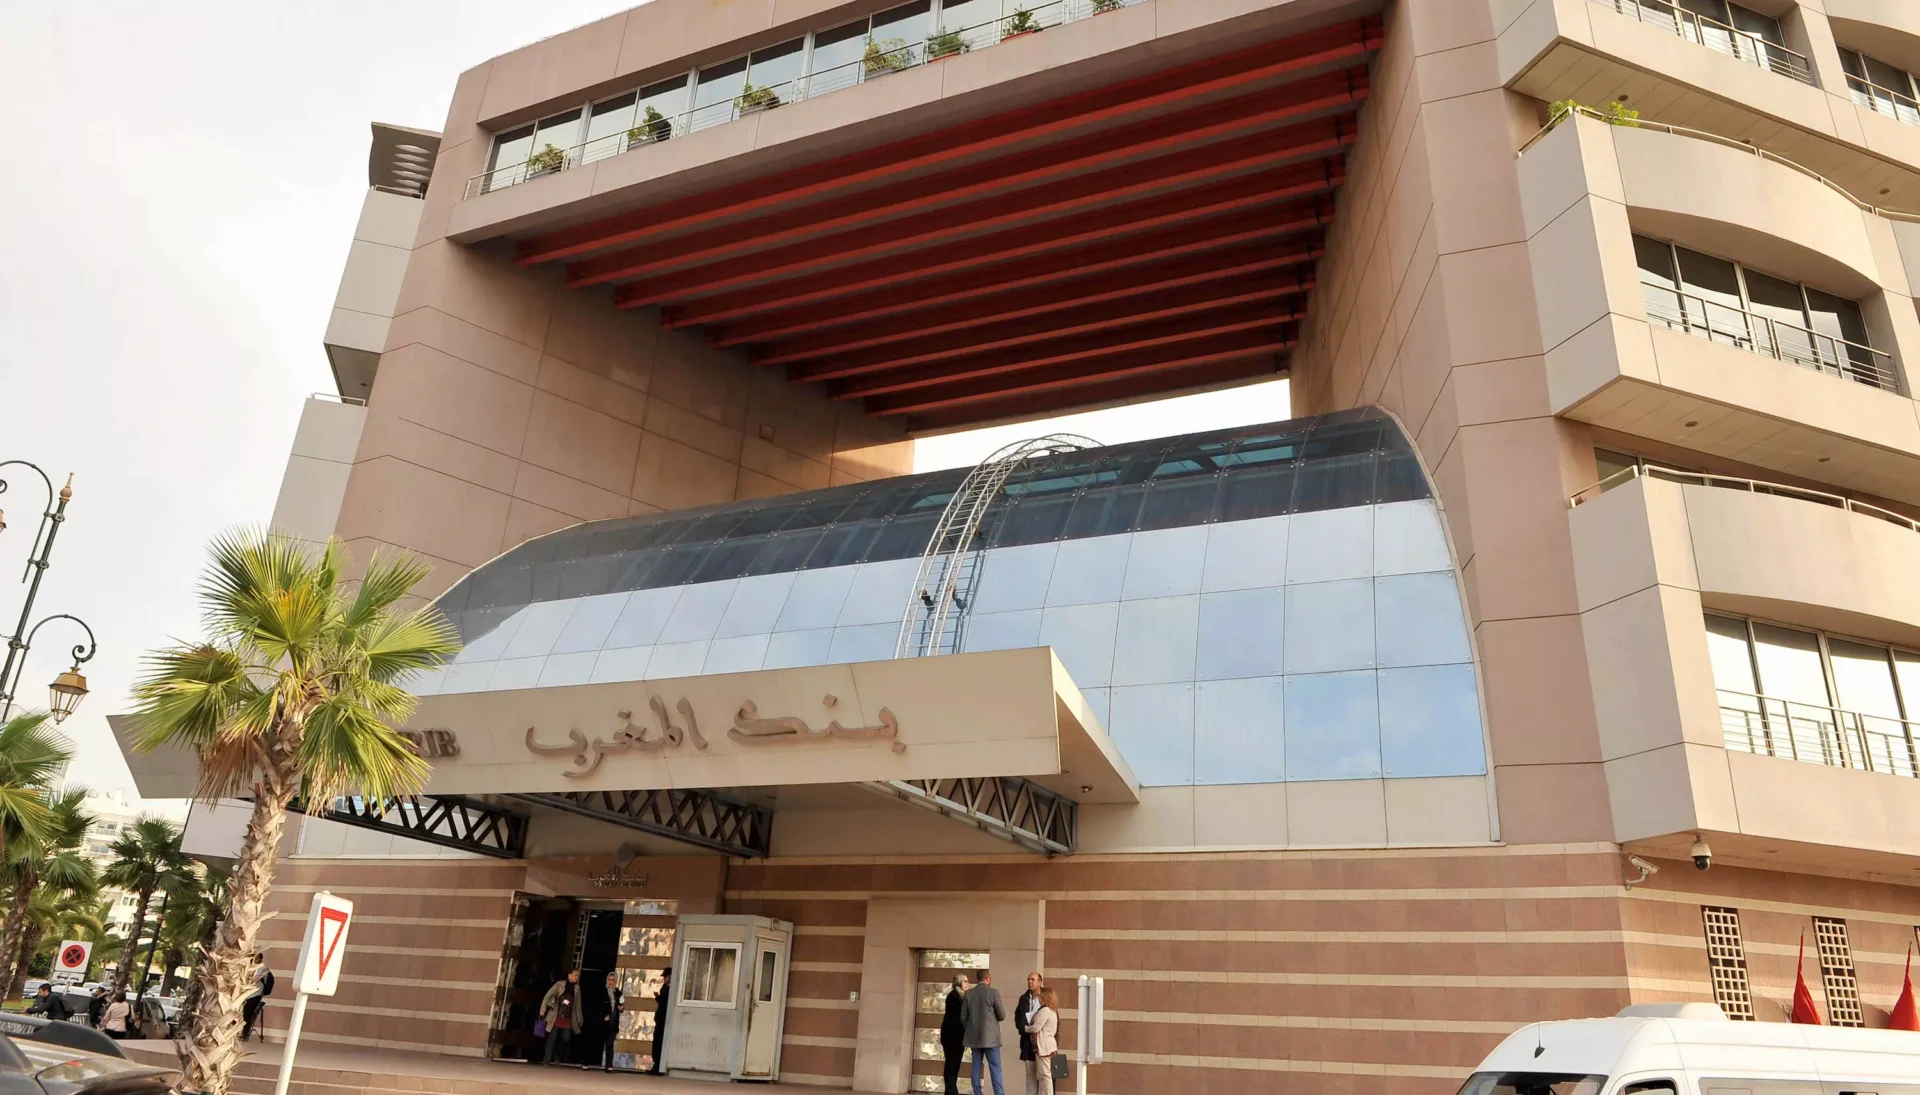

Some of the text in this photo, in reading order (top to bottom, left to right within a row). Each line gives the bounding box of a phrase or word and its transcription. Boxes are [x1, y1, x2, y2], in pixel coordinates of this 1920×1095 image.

[395, 728, 461, 759] RIB
[525, 693, 906, 778] بنك المغرب
